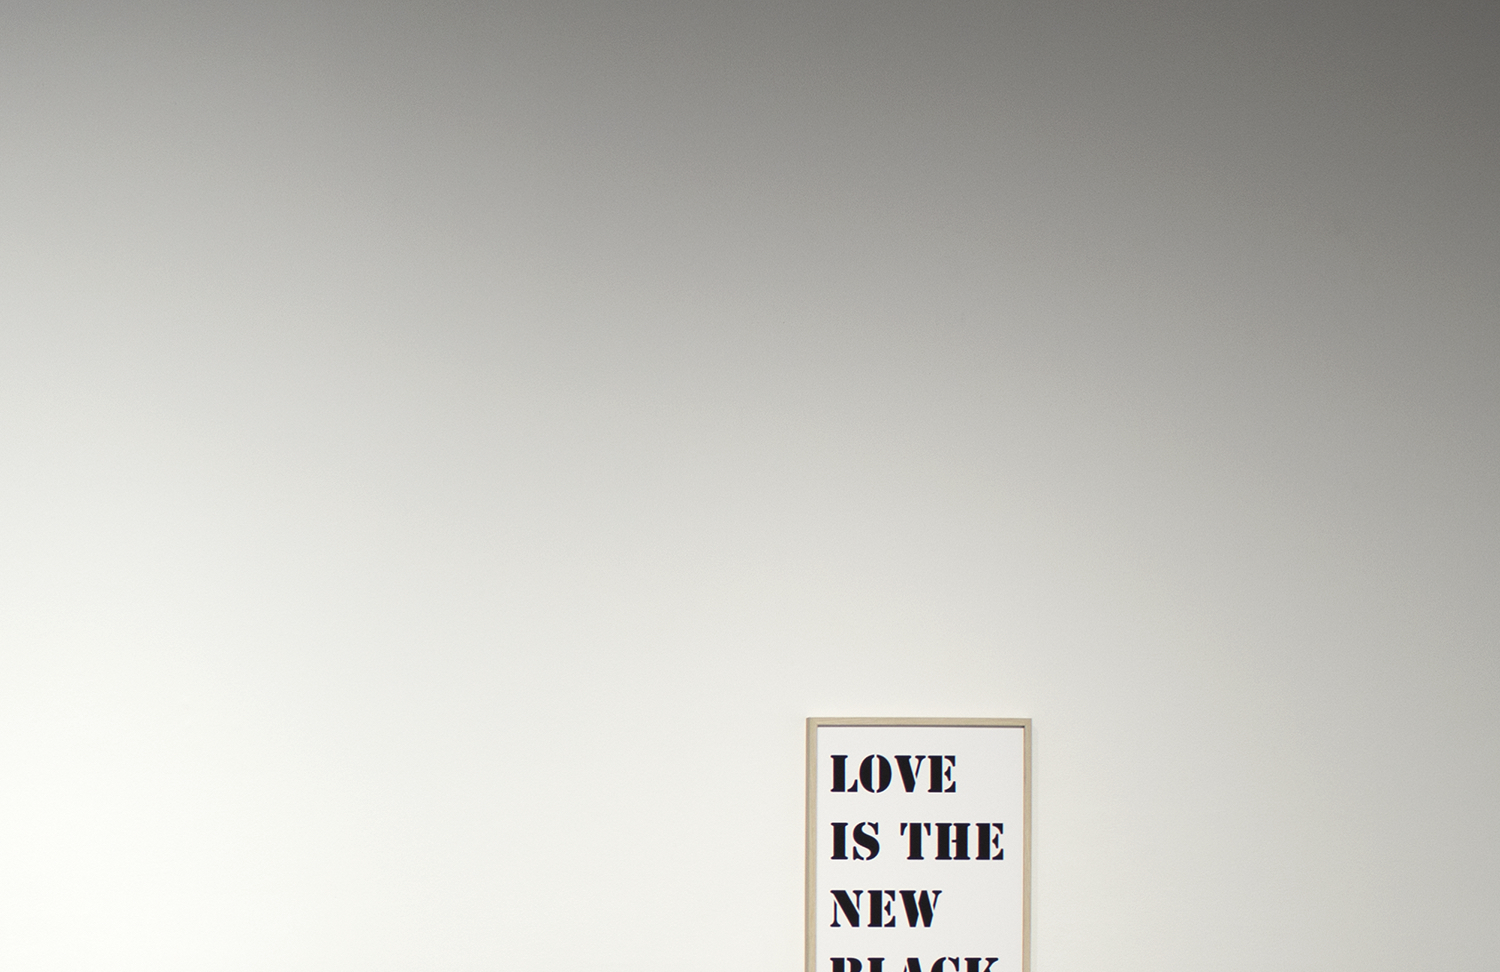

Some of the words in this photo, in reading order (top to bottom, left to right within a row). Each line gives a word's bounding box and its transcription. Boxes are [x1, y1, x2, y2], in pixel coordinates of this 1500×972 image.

[830, 754, 957, 793] LOVE
[830, 821, 881, 861] IS
[900, 822, 1004, 861] THE
[830, 889, 943, 928] NEW
